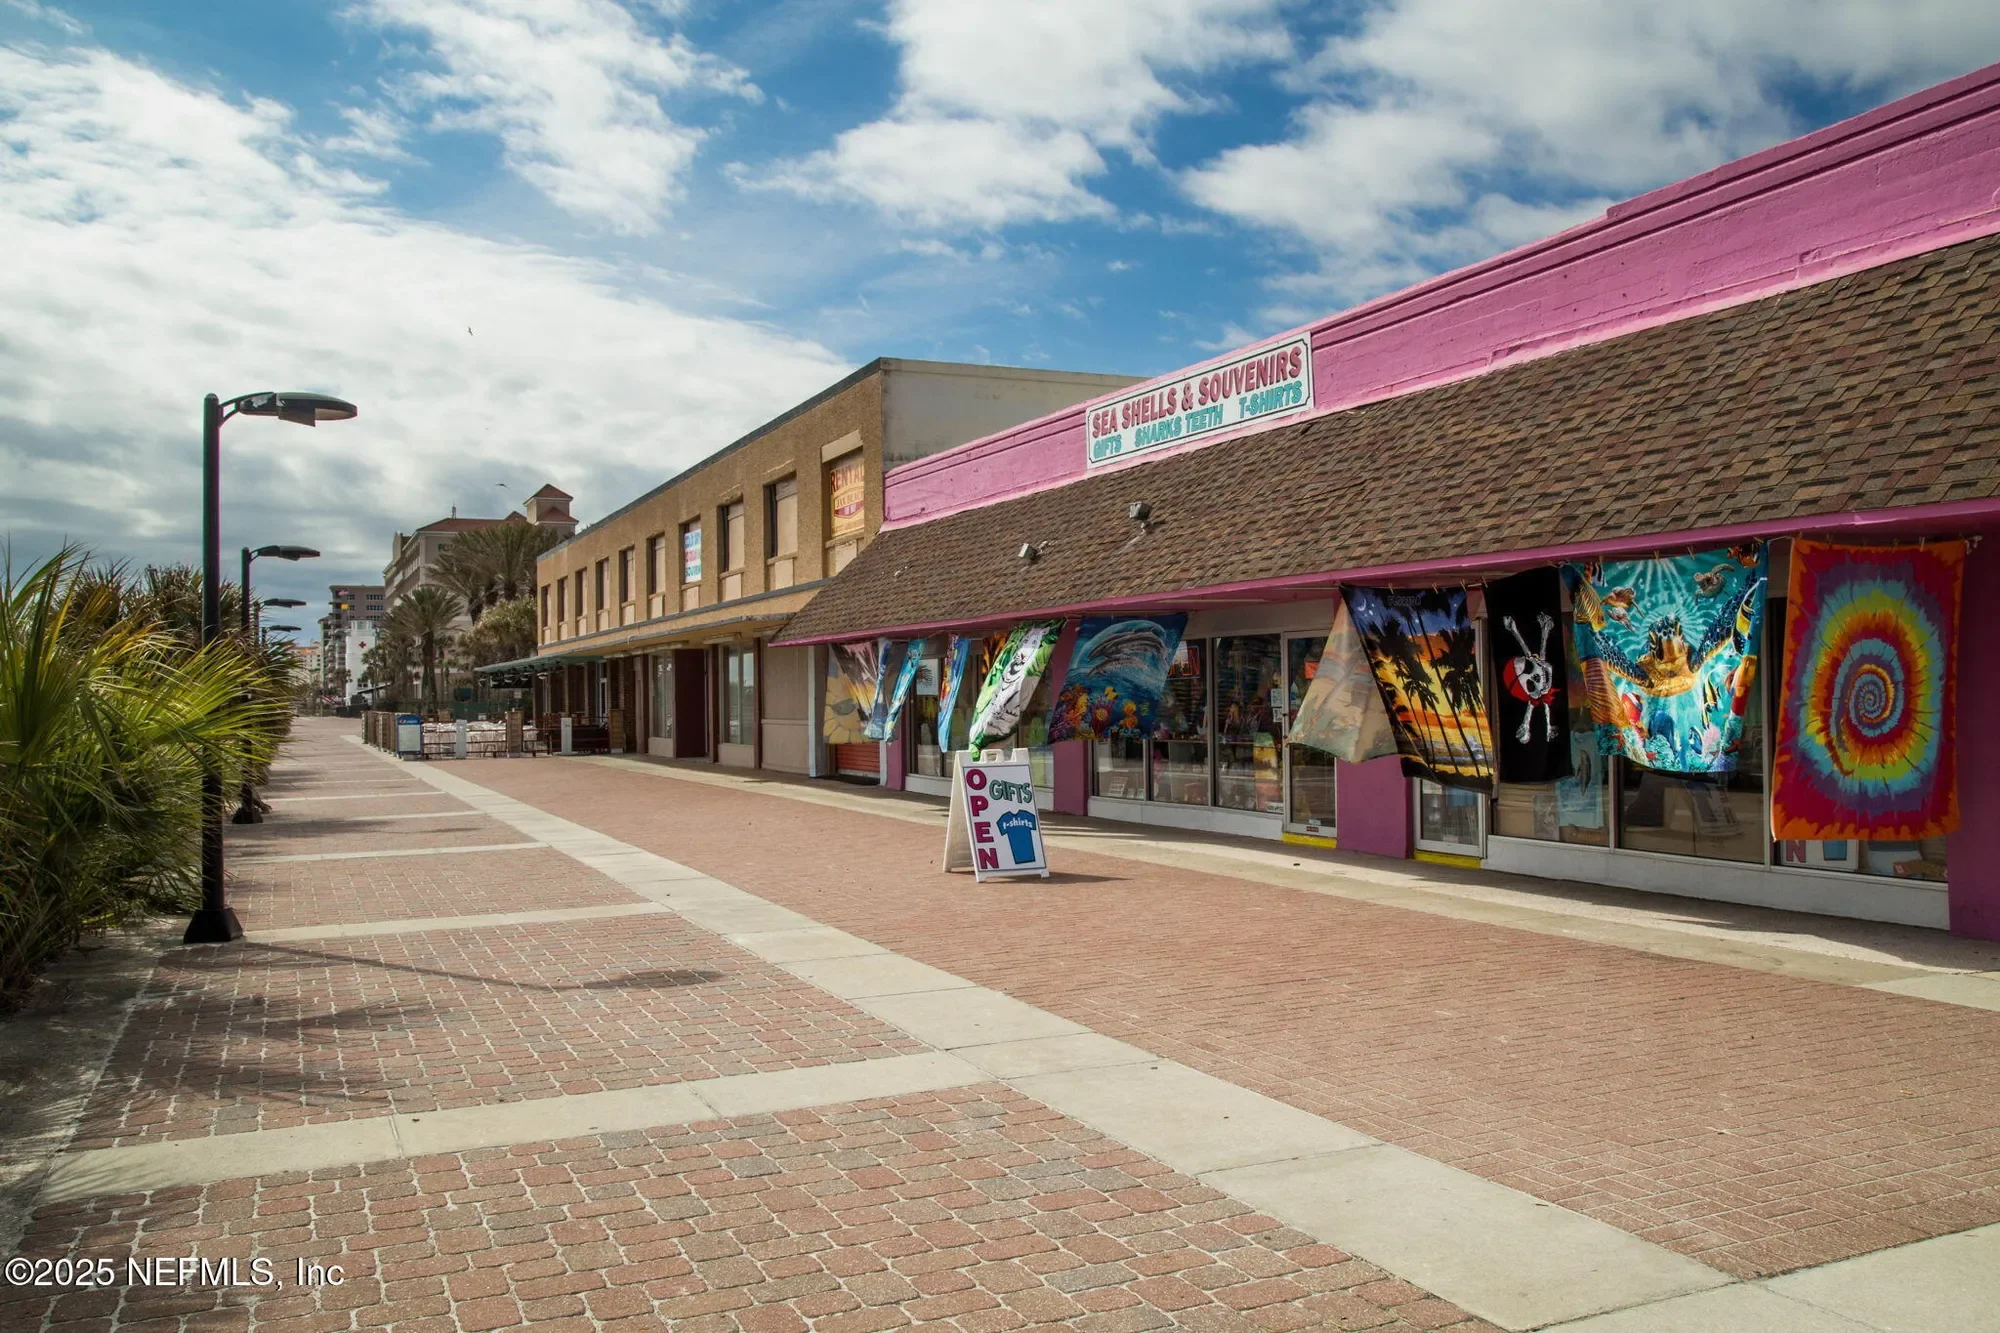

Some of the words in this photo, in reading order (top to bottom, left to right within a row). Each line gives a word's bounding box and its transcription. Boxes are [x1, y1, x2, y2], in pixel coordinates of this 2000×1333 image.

[1092, 411, 1118, 438] SEA
[1122, 387, 1177, 429] SHELLS
[1181, 383, 1194, 411] &
[1198, 346, 1302, 406] SOUVENIRS
[1093, 434, 1123, 460] GIFTS
[1134, 416, 1182, 448] SHARKS
[1184, 404, 1224, 435] TEETH
[1239, 380, 1303, 419] T-SHIRTS
[966, 769, 999, 869] OPEN
[989, 779, 1033, 804] GIFTS
[1002, 817, 1033, 830] t-shirts
